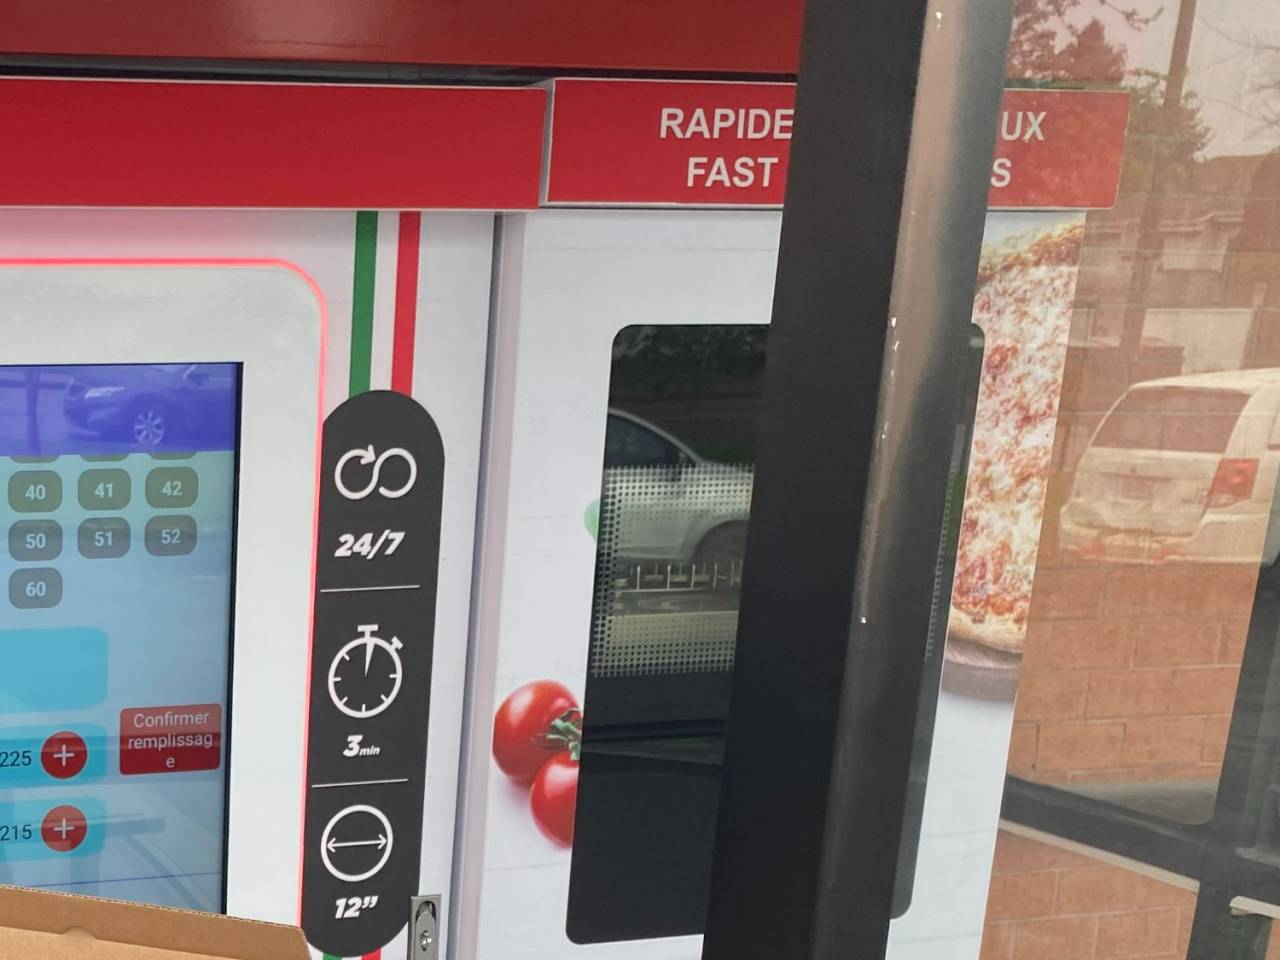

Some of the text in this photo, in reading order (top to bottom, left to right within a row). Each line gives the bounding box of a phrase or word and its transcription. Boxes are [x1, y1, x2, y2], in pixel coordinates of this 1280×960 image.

[659, 107, 1048, 143] RAPIDE UX
[686, 156, 778, 187] FAST
[25, 484, 46, 501] 40
[94, 482, 114, 499] 41
[162, 480, 183, 496] 42
[25, 533, 46, 550] 50
[94, 531, 113, 547] 51
[161, 529, 182, 545] 52
[335, 531, 406, 558] 24/7
[25, 581, 47, 598] 60
[133, 710, 210, 727] Confirmer
[128, 733, 214, 752] remplissag
[166, 756, 176, 768] e
[0, 825, 33, 841] 215
